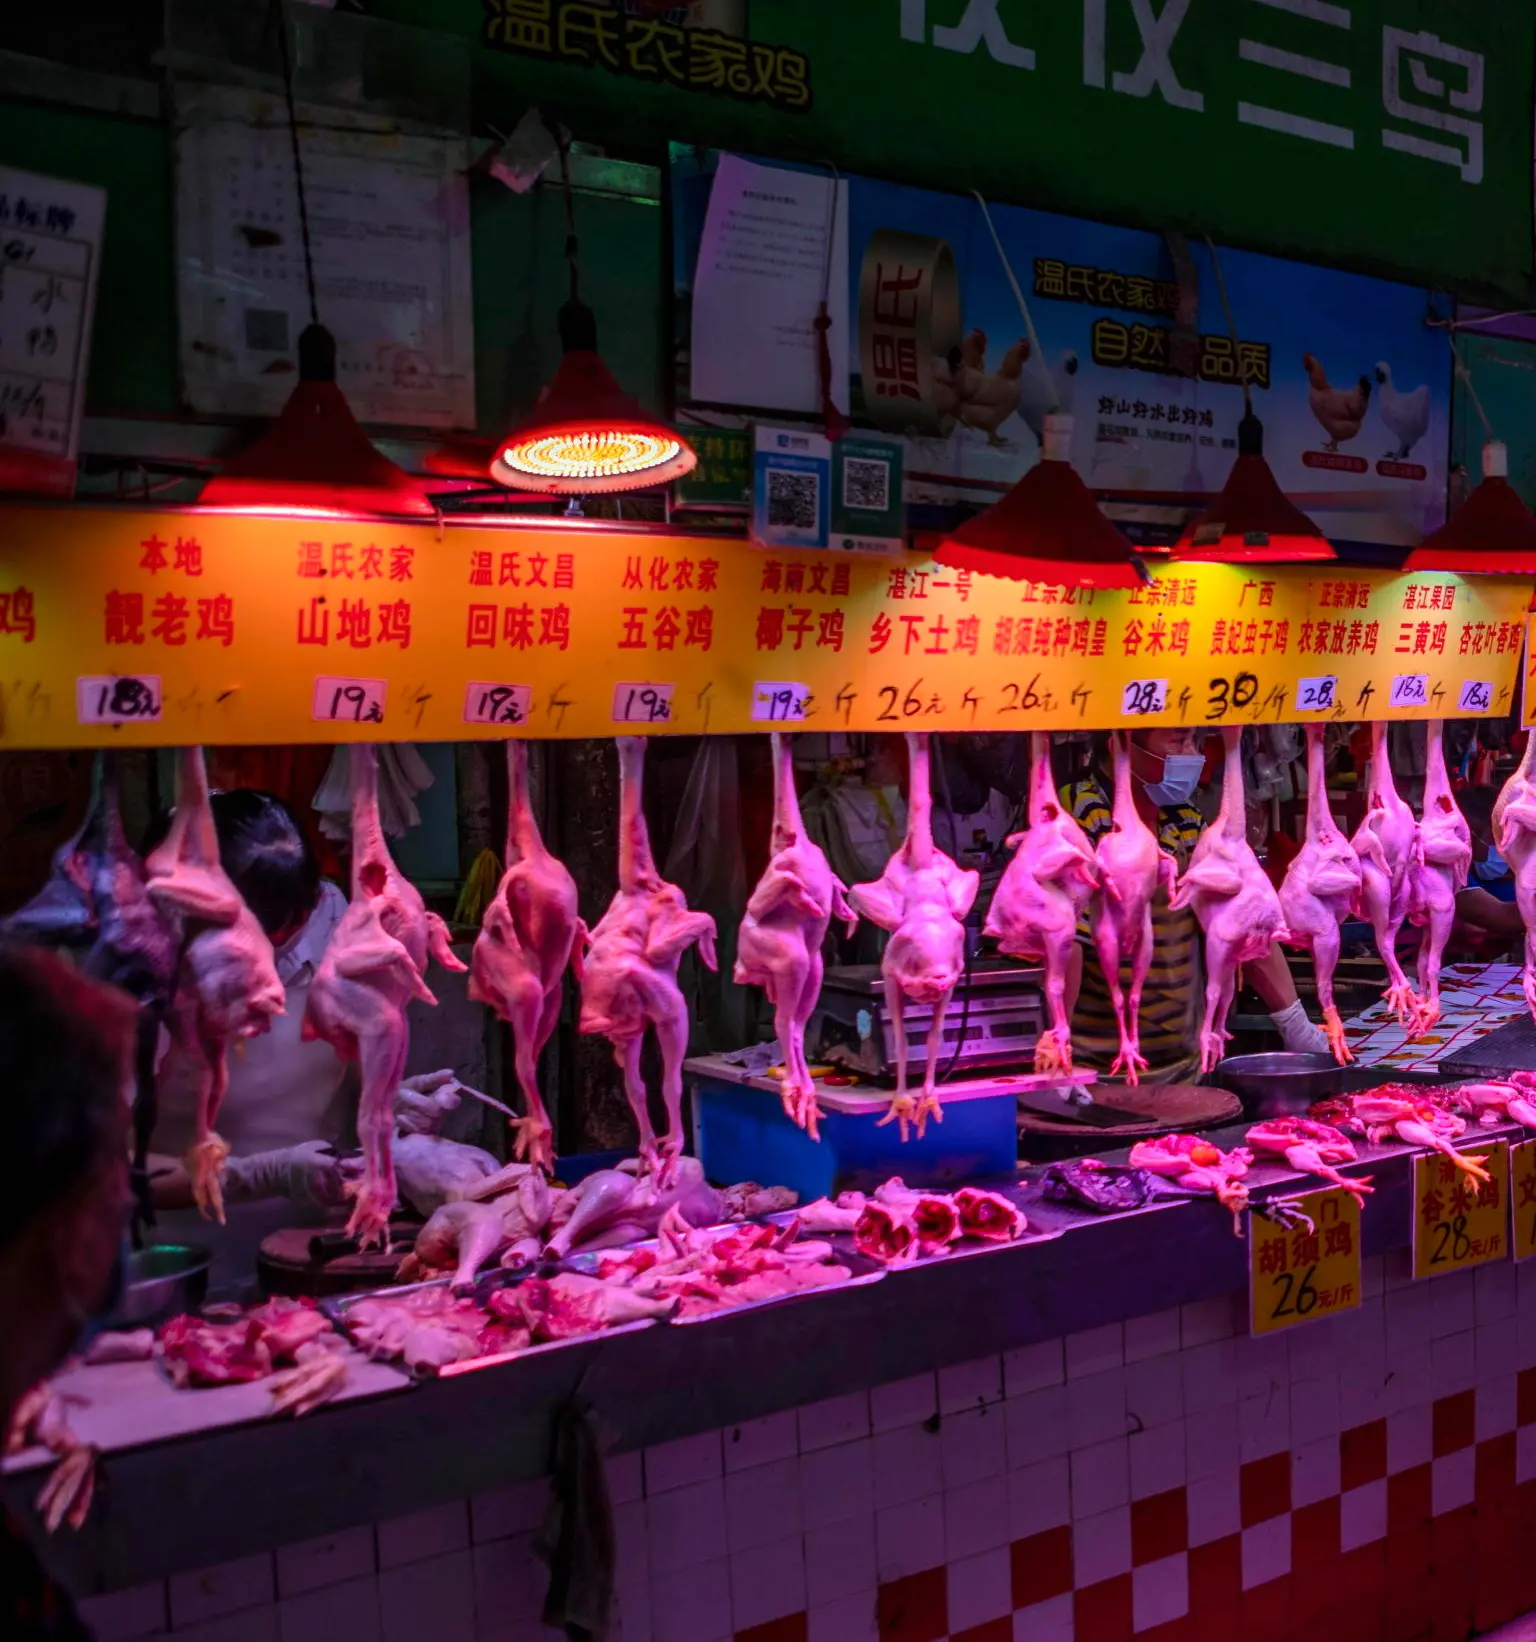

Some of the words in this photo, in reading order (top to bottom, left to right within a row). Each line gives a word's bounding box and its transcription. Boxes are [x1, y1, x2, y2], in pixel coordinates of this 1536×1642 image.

[486, 0, 810, 105] 温氏农家鸡
[1035, 258, 1181, 312] 温氏农家鸡
[873, 262, 924, 402] 温氏
[1094, 321, 1270, 385] 自然品质
[139, 535, 204, 576] 本地
[297, 541, 415, 582] 温氏农家
[469, 551, 575, 590] 温氏文昌
[622, 555, 720, 592] 从化农家
[761, 560, 852, 597] 海南文昌
[886, 567, 973, 602] 湛江一号
[1239, 579, 1277, 608] 广西
[1318, 581, 1372, 610] 正宗清远
[1402, 583, 1456, 611] 湛江果园
[104, 590, 235, 646] 靓老鸡
[297, 597, 412, 650] 山地鸡
[466, 602, 571, 652] 回味鸡
[617, 605, 715, 652] 五谷鸡
[755, 606, 845, 653] 椰子鸡
[868, 611, 980, 656] 乡下土鸡
[1122, 618, 1191, 657] 谷米鸡
[1209, 619, 1290, 657] 贵妃虫子鸡
[1297, 619, 1380, 657] 农家放养鸡
[1394, 619, 1448, 656] 三黄鸡
[1458, 620, 1524, 656] 杏花叶香鸡
[1421, 1176, 1500, 1226] 谷米鸡
[1259, 1221, 1353, 1275] 胡须鸡
